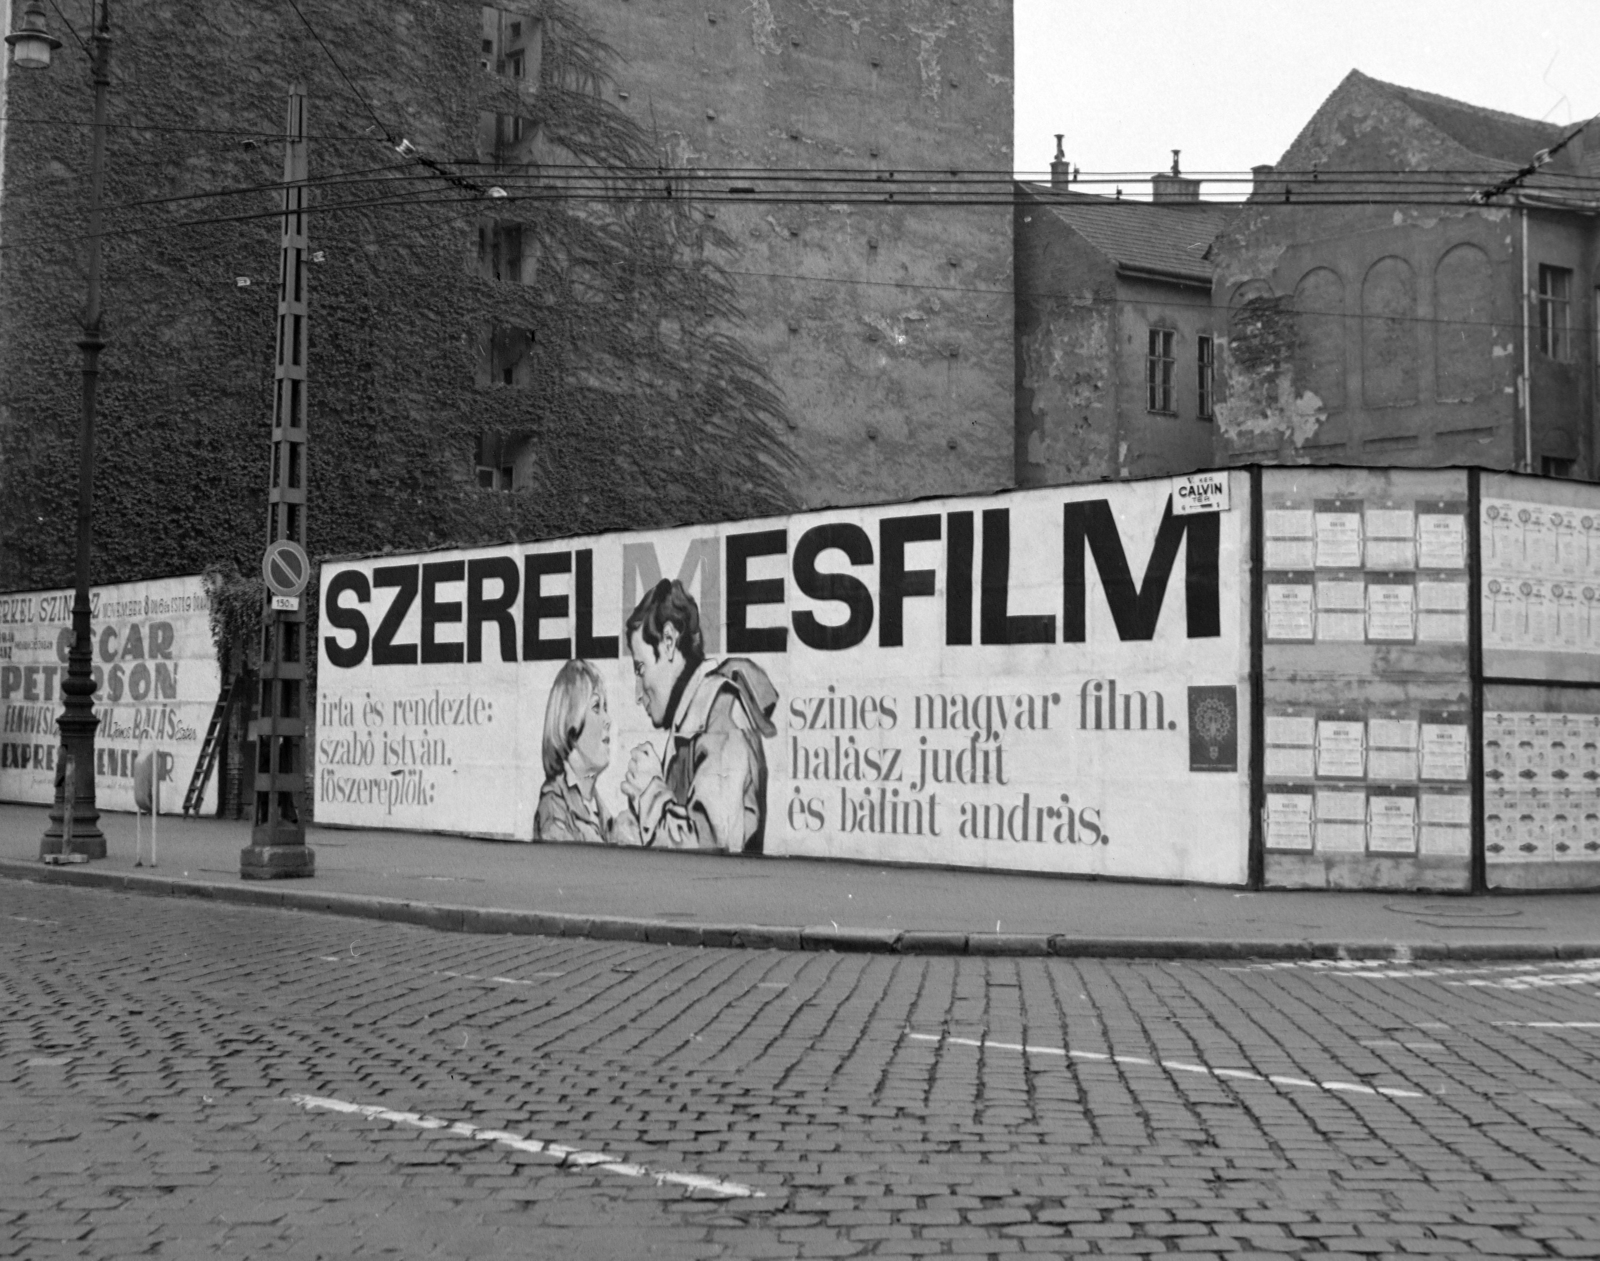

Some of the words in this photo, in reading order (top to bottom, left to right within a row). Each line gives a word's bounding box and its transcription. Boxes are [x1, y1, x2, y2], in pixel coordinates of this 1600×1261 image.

[1178, 482, 1223, 498] CALVIN
[324, 493, 1221, 669] SZERELMESFILM
[39, 592, 100, 623] SZINZ
[393, 689, 493, 727] rendezte:
[914, 692, 1061, 743] magyar
[1076, 679, 1177, 731] film.
[1, 742, 56, 771] EXPRE
[910, 735, 1010, 792] judit
